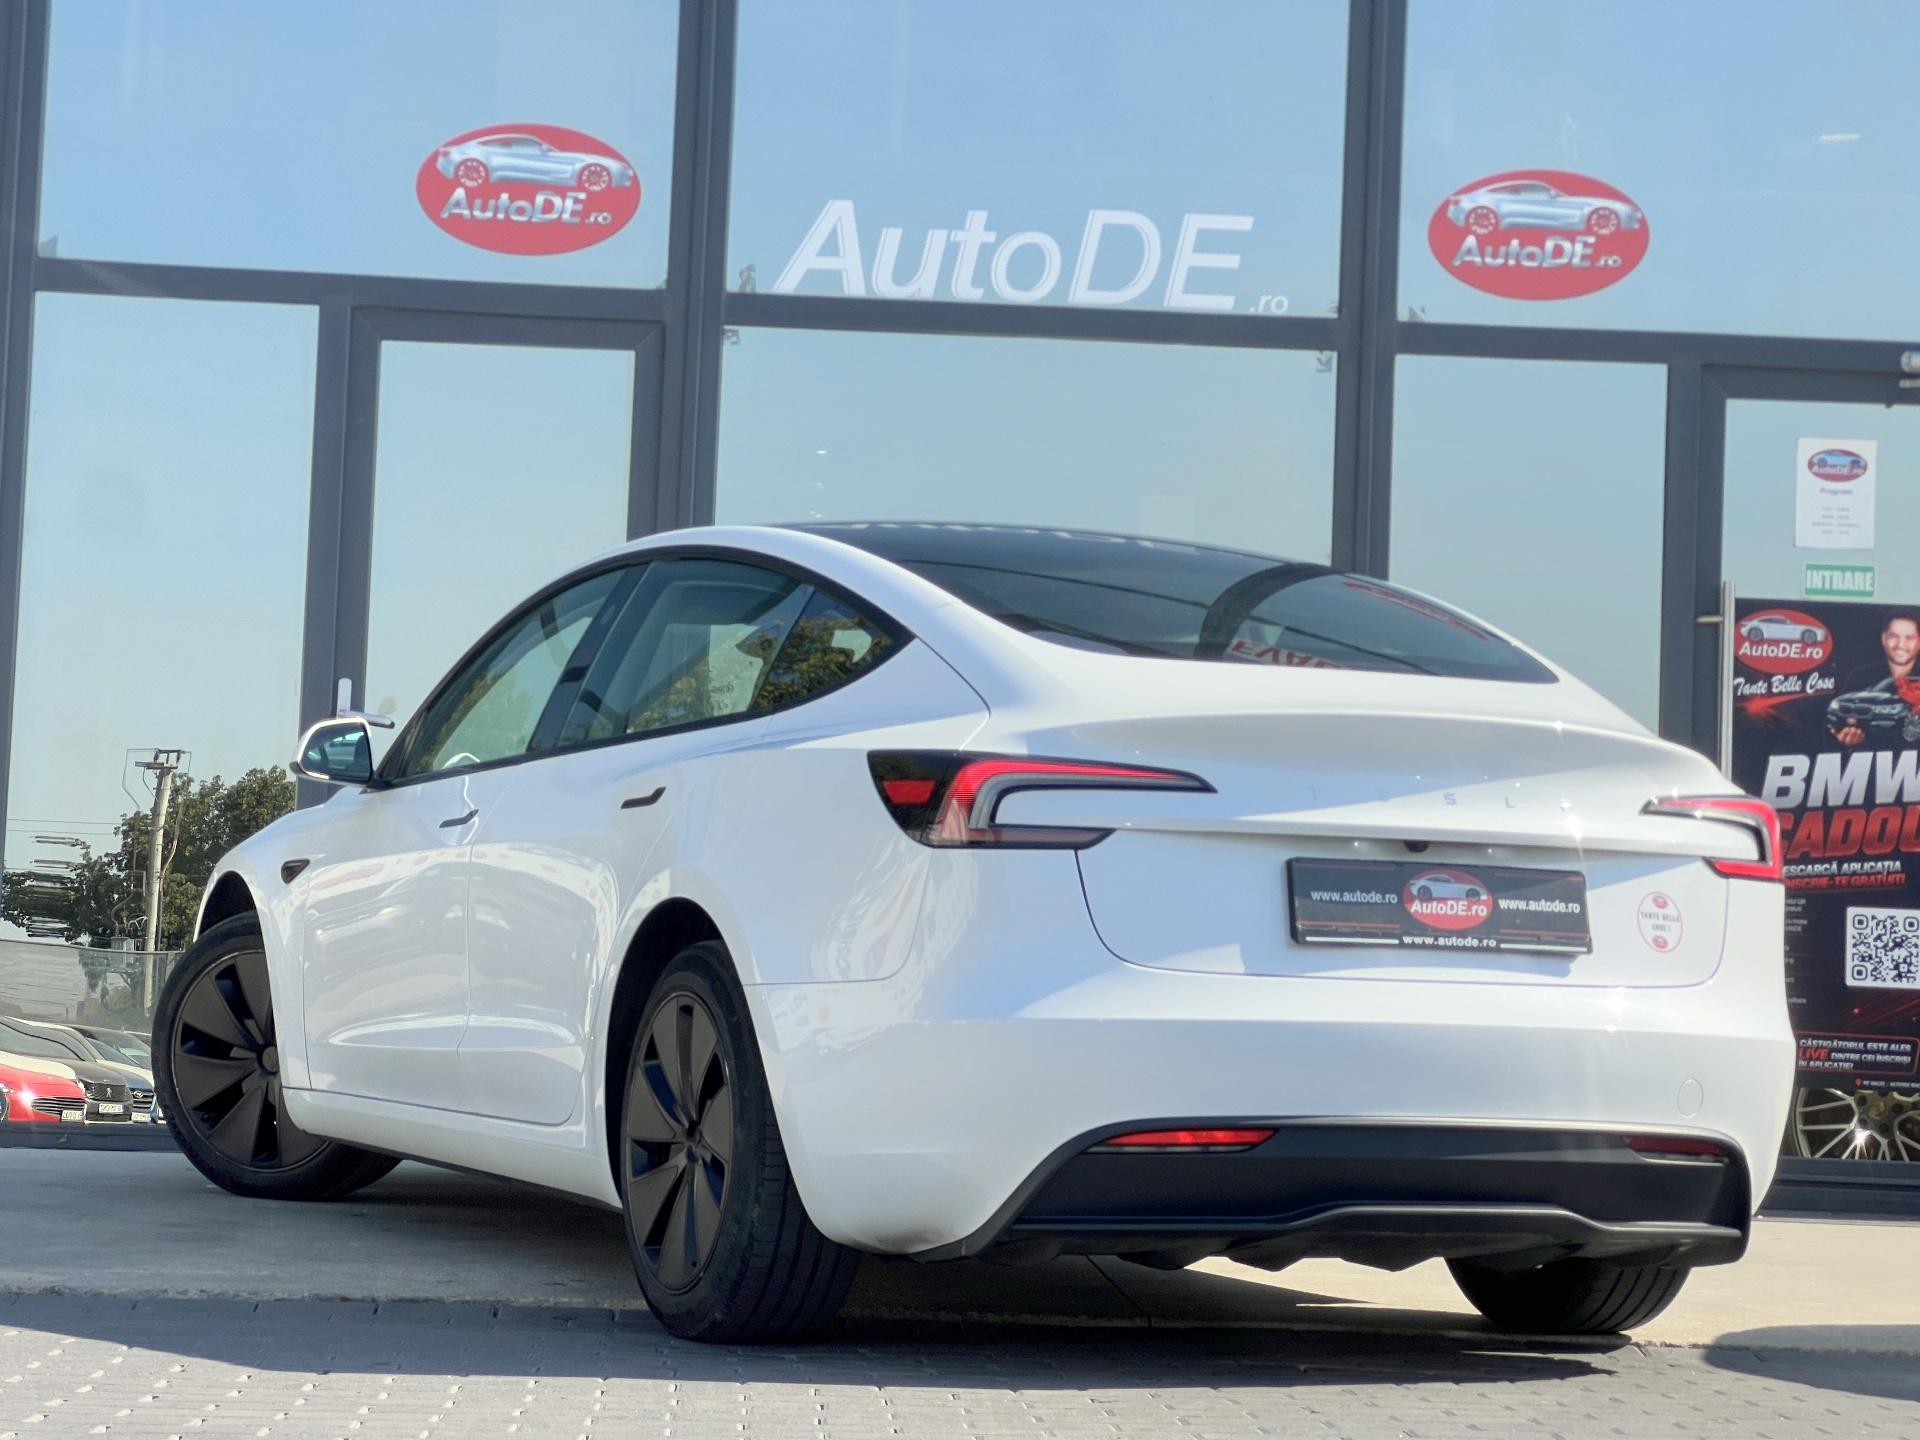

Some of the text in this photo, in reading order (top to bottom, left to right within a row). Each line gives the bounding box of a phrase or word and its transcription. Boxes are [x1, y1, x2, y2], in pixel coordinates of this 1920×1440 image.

[1806, 569, 1874, 592] INTRARE
[1739, 641, 1823, 659] AutoDE.ro
[1733, 672, 1835, 696] Tante Belle Cose
[1761, 750, 1920, 809] BMW
[1783, 860, 1838, 875] ESCARCĂ
[1310, 889, 1398, 904] www.autode.ro
[1410, 899, 1488, 917] AutoDE.ro
[1498, 898, 1581, 914] www.autode.ro
[1402, 934, 1497, 948] www.autode.ro
[1799, 1048, 1830, 1060] LIVE
